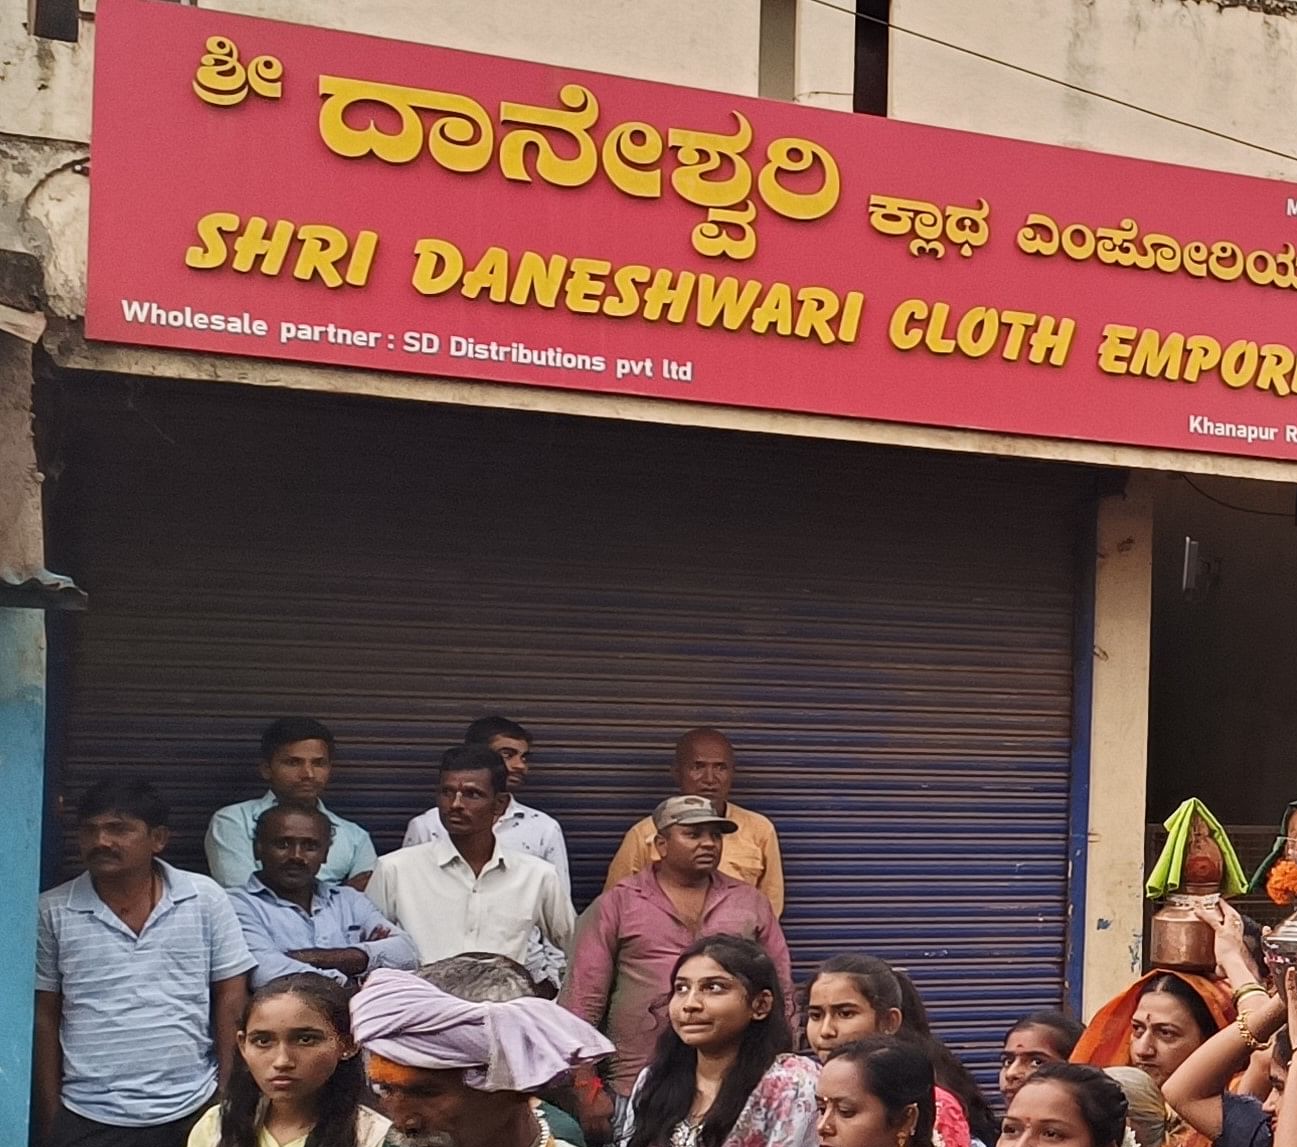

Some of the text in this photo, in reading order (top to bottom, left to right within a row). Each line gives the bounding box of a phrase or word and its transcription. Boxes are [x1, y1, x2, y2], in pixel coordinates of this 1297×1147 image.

[192, 36, 283, 106] ಶ್ರೀ
[318, 74, 841, 261] ದಾನೇಶ್ವರಿ
[121, 299, 268, 336] Wholesale
[280, 321, 382, 348] partner
[403, 331, 440, 354] SD
[450, 336, 606, 372] Distributions
[616, 358, 653, 378] pvt
[663, 358, 693, 381] ltd
[185, 212, 378, 288] SHRI
[411, 238, 864, 346] DANESHWARI
[889, 298, 1075, 367] CLOTH
[1189, 415, 1279, 442] Khanapur
